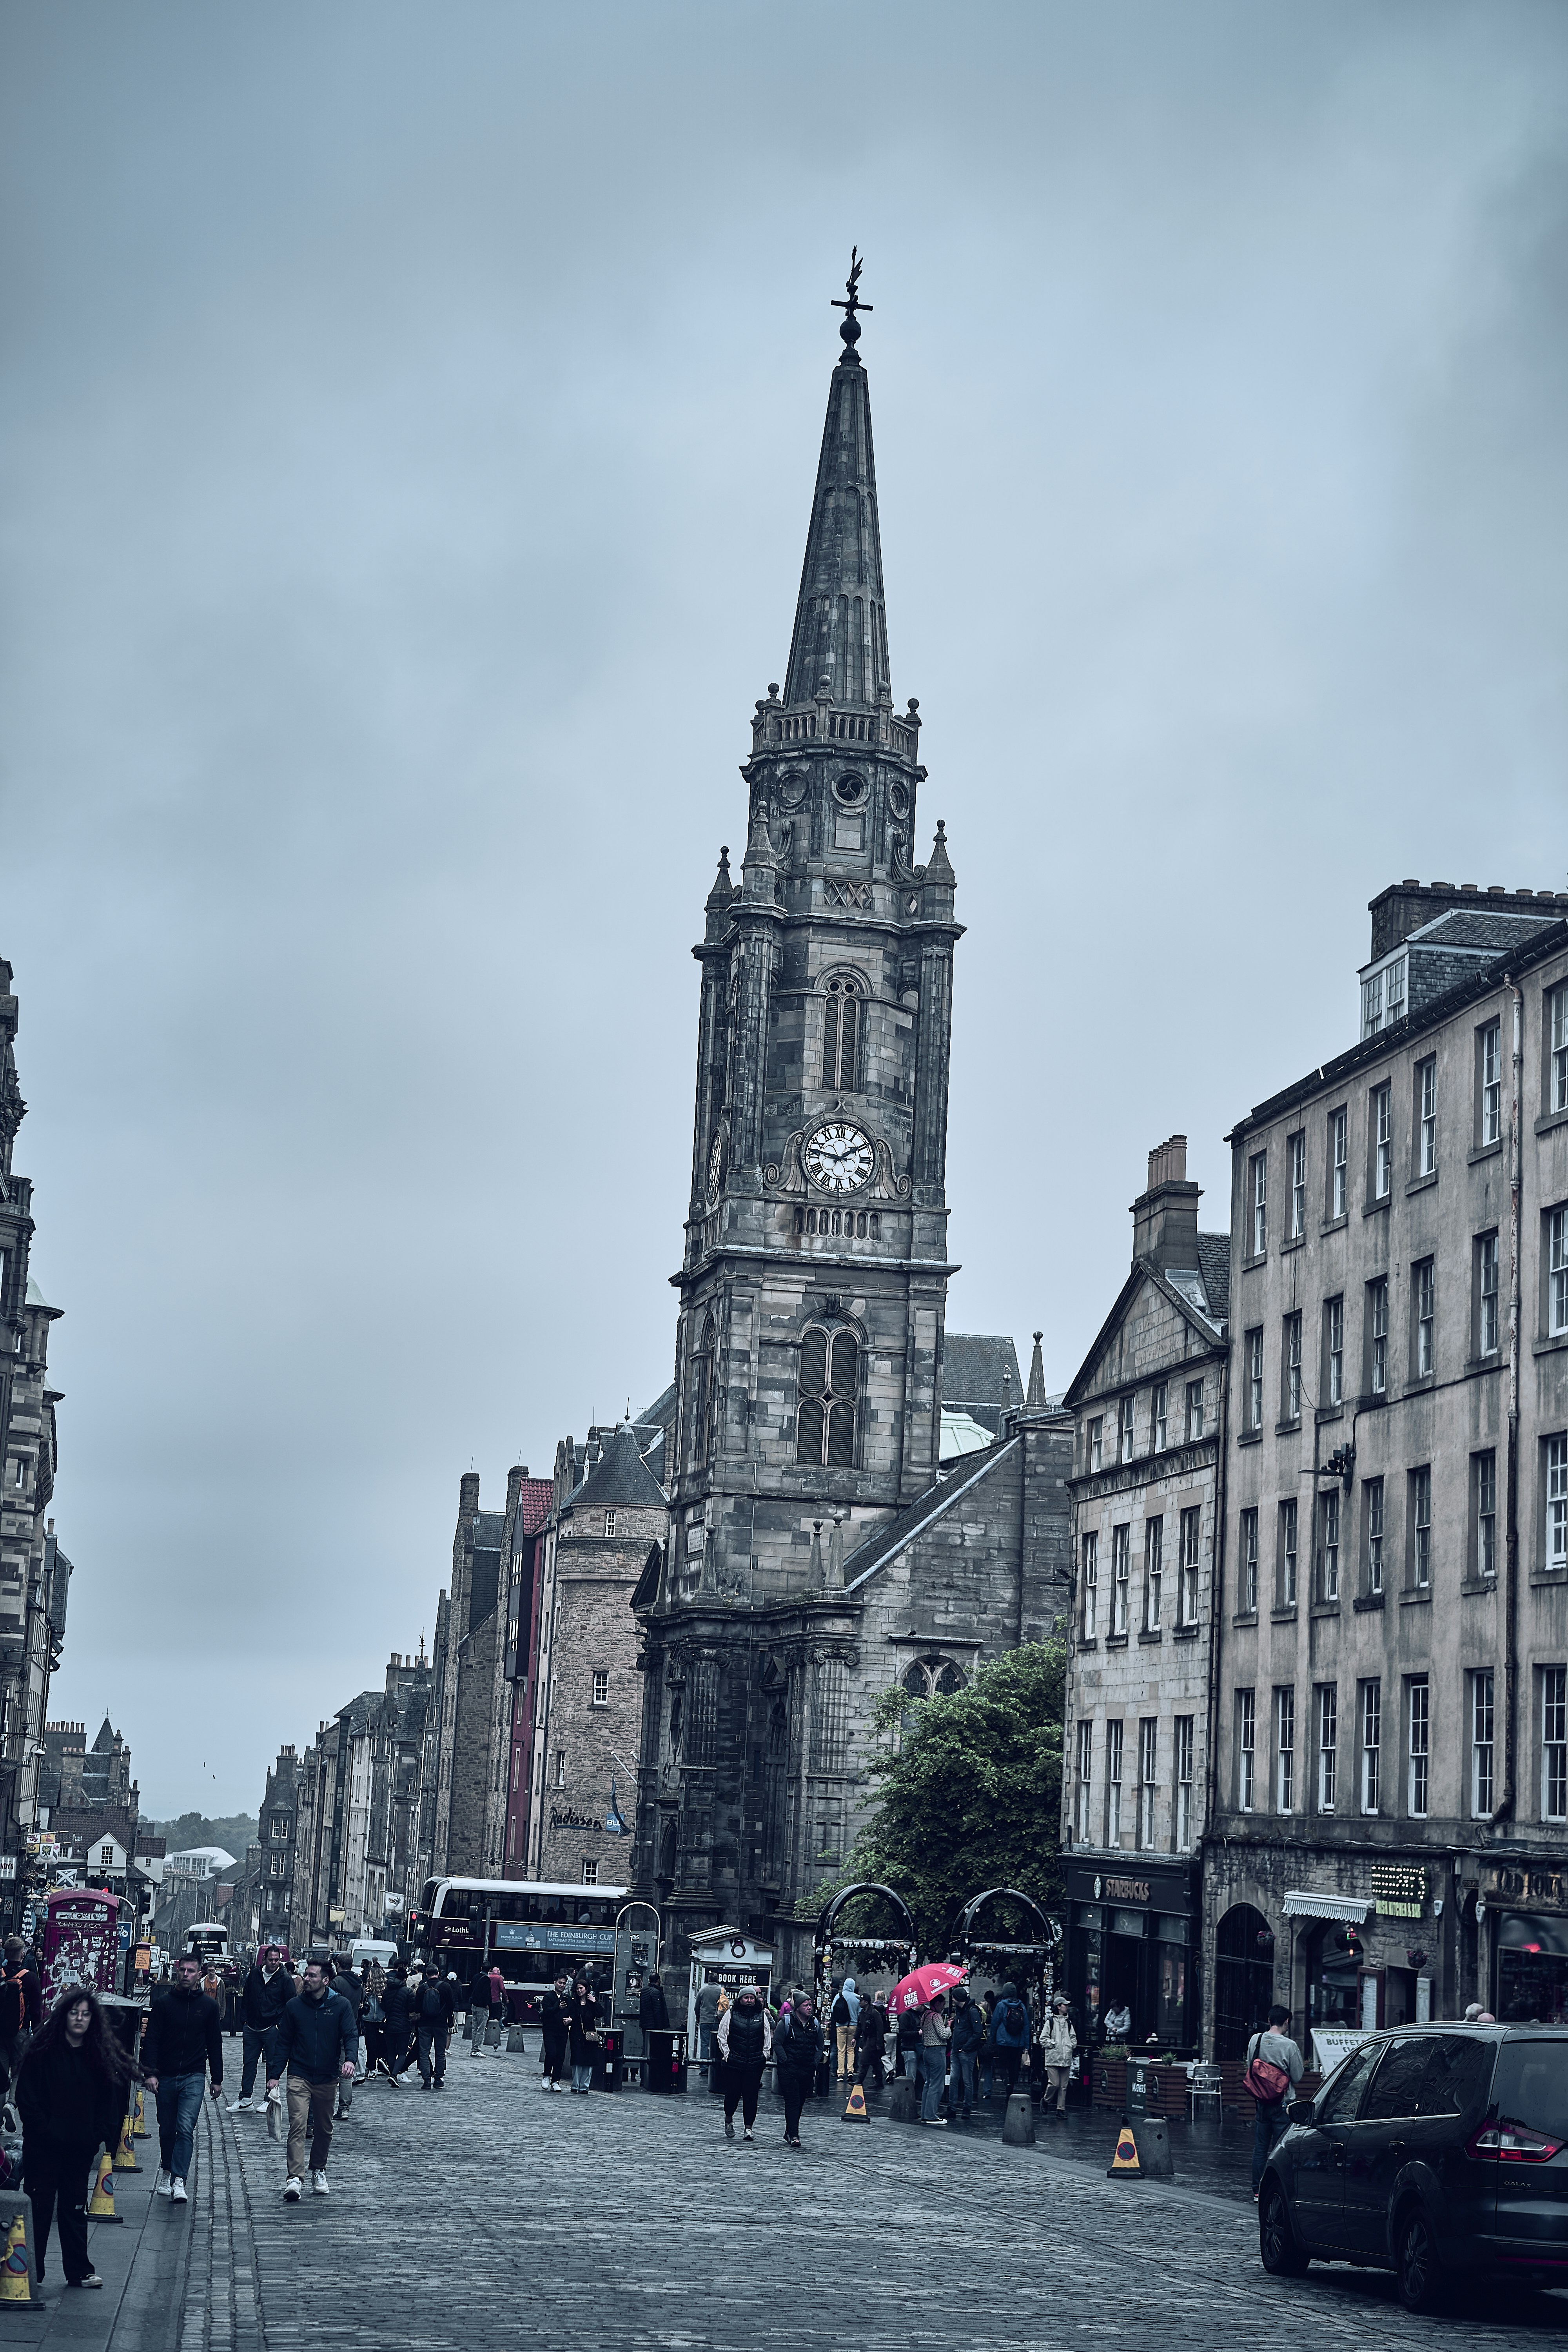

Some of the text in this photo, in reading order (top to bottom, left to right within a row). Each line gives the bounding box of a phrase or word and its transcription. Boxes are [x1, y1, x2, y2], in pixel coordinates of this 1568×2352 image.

[822, 1129, 833, 1142] XI
[835, 1127, 846, 1138] XII
[849, 1132, 857, 1141] I
[811, 1138, 825, 1149] X
[835, 1178, 843, 1189] VI
[848, 1177, 858, 1188] V
[550, 1806, 603, 1831] Radisson
[1497, 1867, 1563, 1897] OLD TOWN
[1106, 1879, 1149, 1901] STARBUCKS
[1388, 1901, 1407, 1916] KITCHEN
[1407, 1902, 1411, 1917] &
[1412, 1904, 1421, 1918] BAR
[718, 1974, 756, 1984] BOOK HERE
[904, 1991, 917, 2001] FREE
[904, 1996, 918, 2006] TOUR
